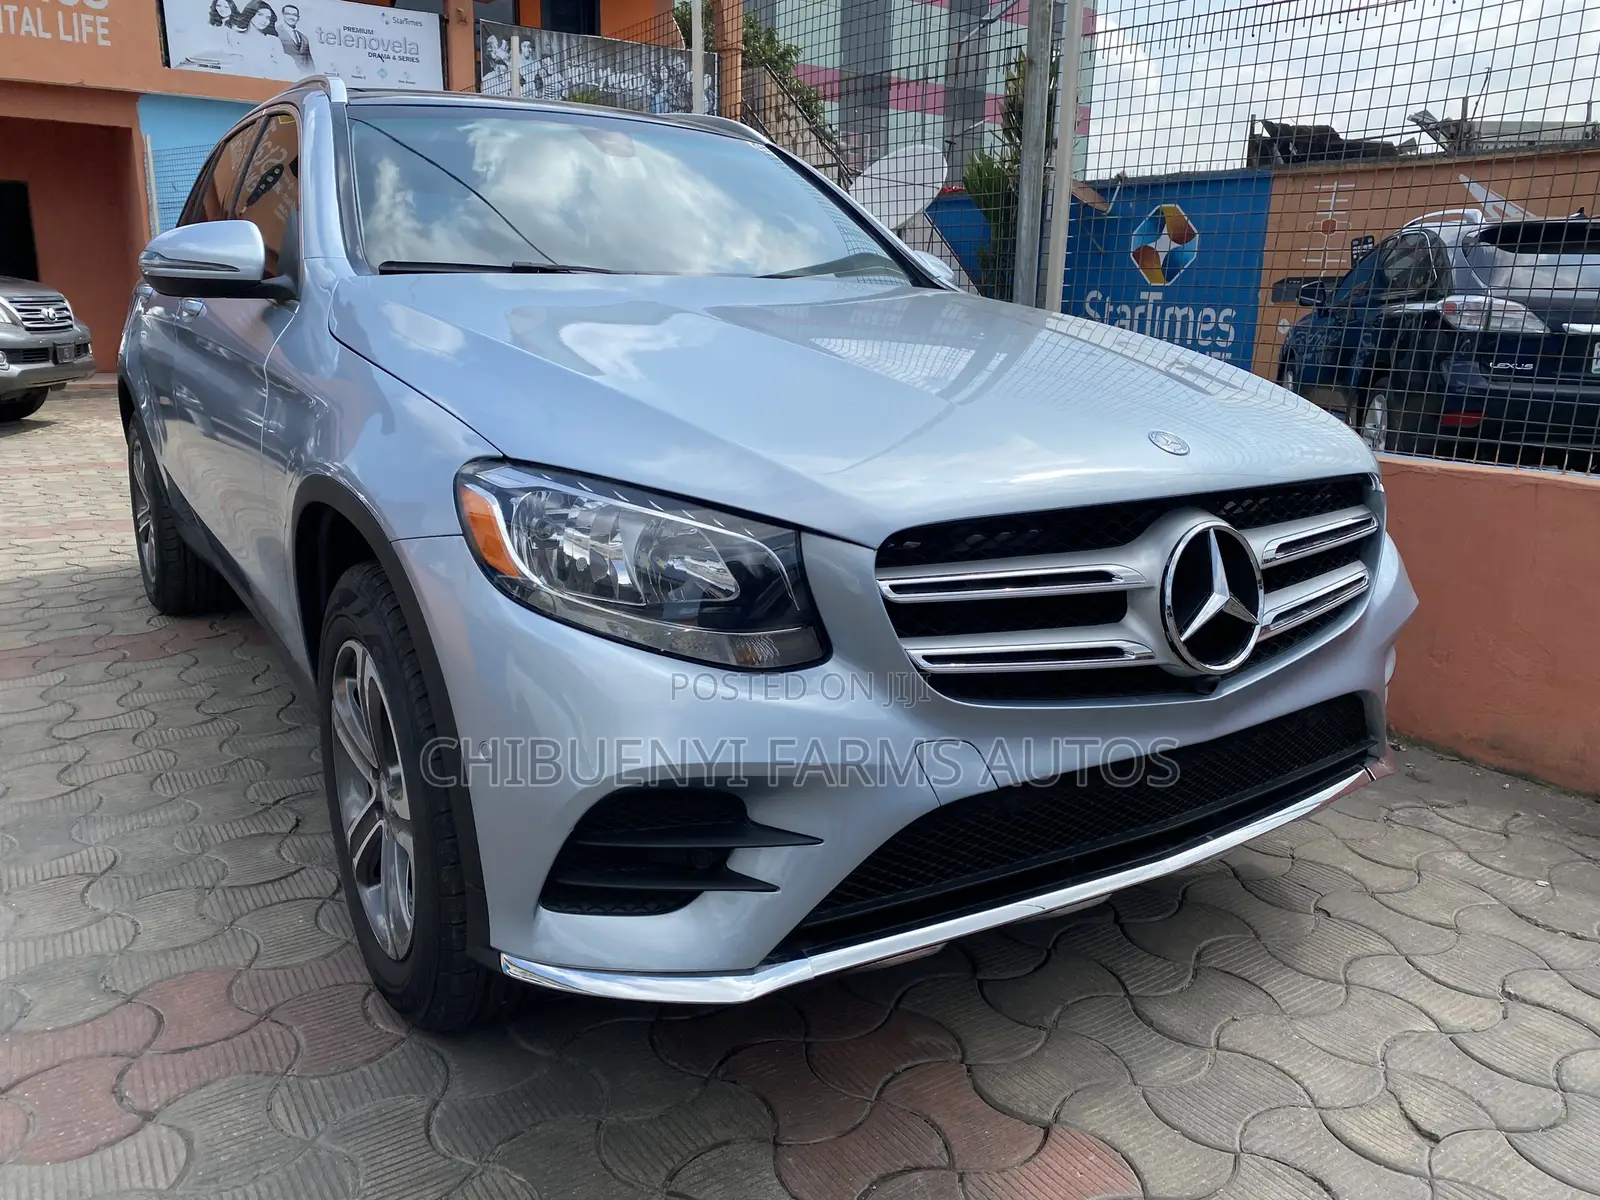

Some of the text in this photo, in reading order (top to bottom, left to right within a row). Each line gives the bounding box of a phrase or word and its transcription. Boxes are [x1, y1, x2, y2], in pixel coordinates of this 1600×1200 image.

[57, 10, 112, 46] LIFE
[392, 16, 423, 27] StarTimes
[343, 26, 374, 35] PREMIUM
[315, 27, 419, 55] telenovela
[367, 51, 391, 61] DRAMA
[398, 55, 420, 64] SERIES
[1085, 290, 1236, 347] StarTimes
[1489, 362, 1534, 370] LEXUS
